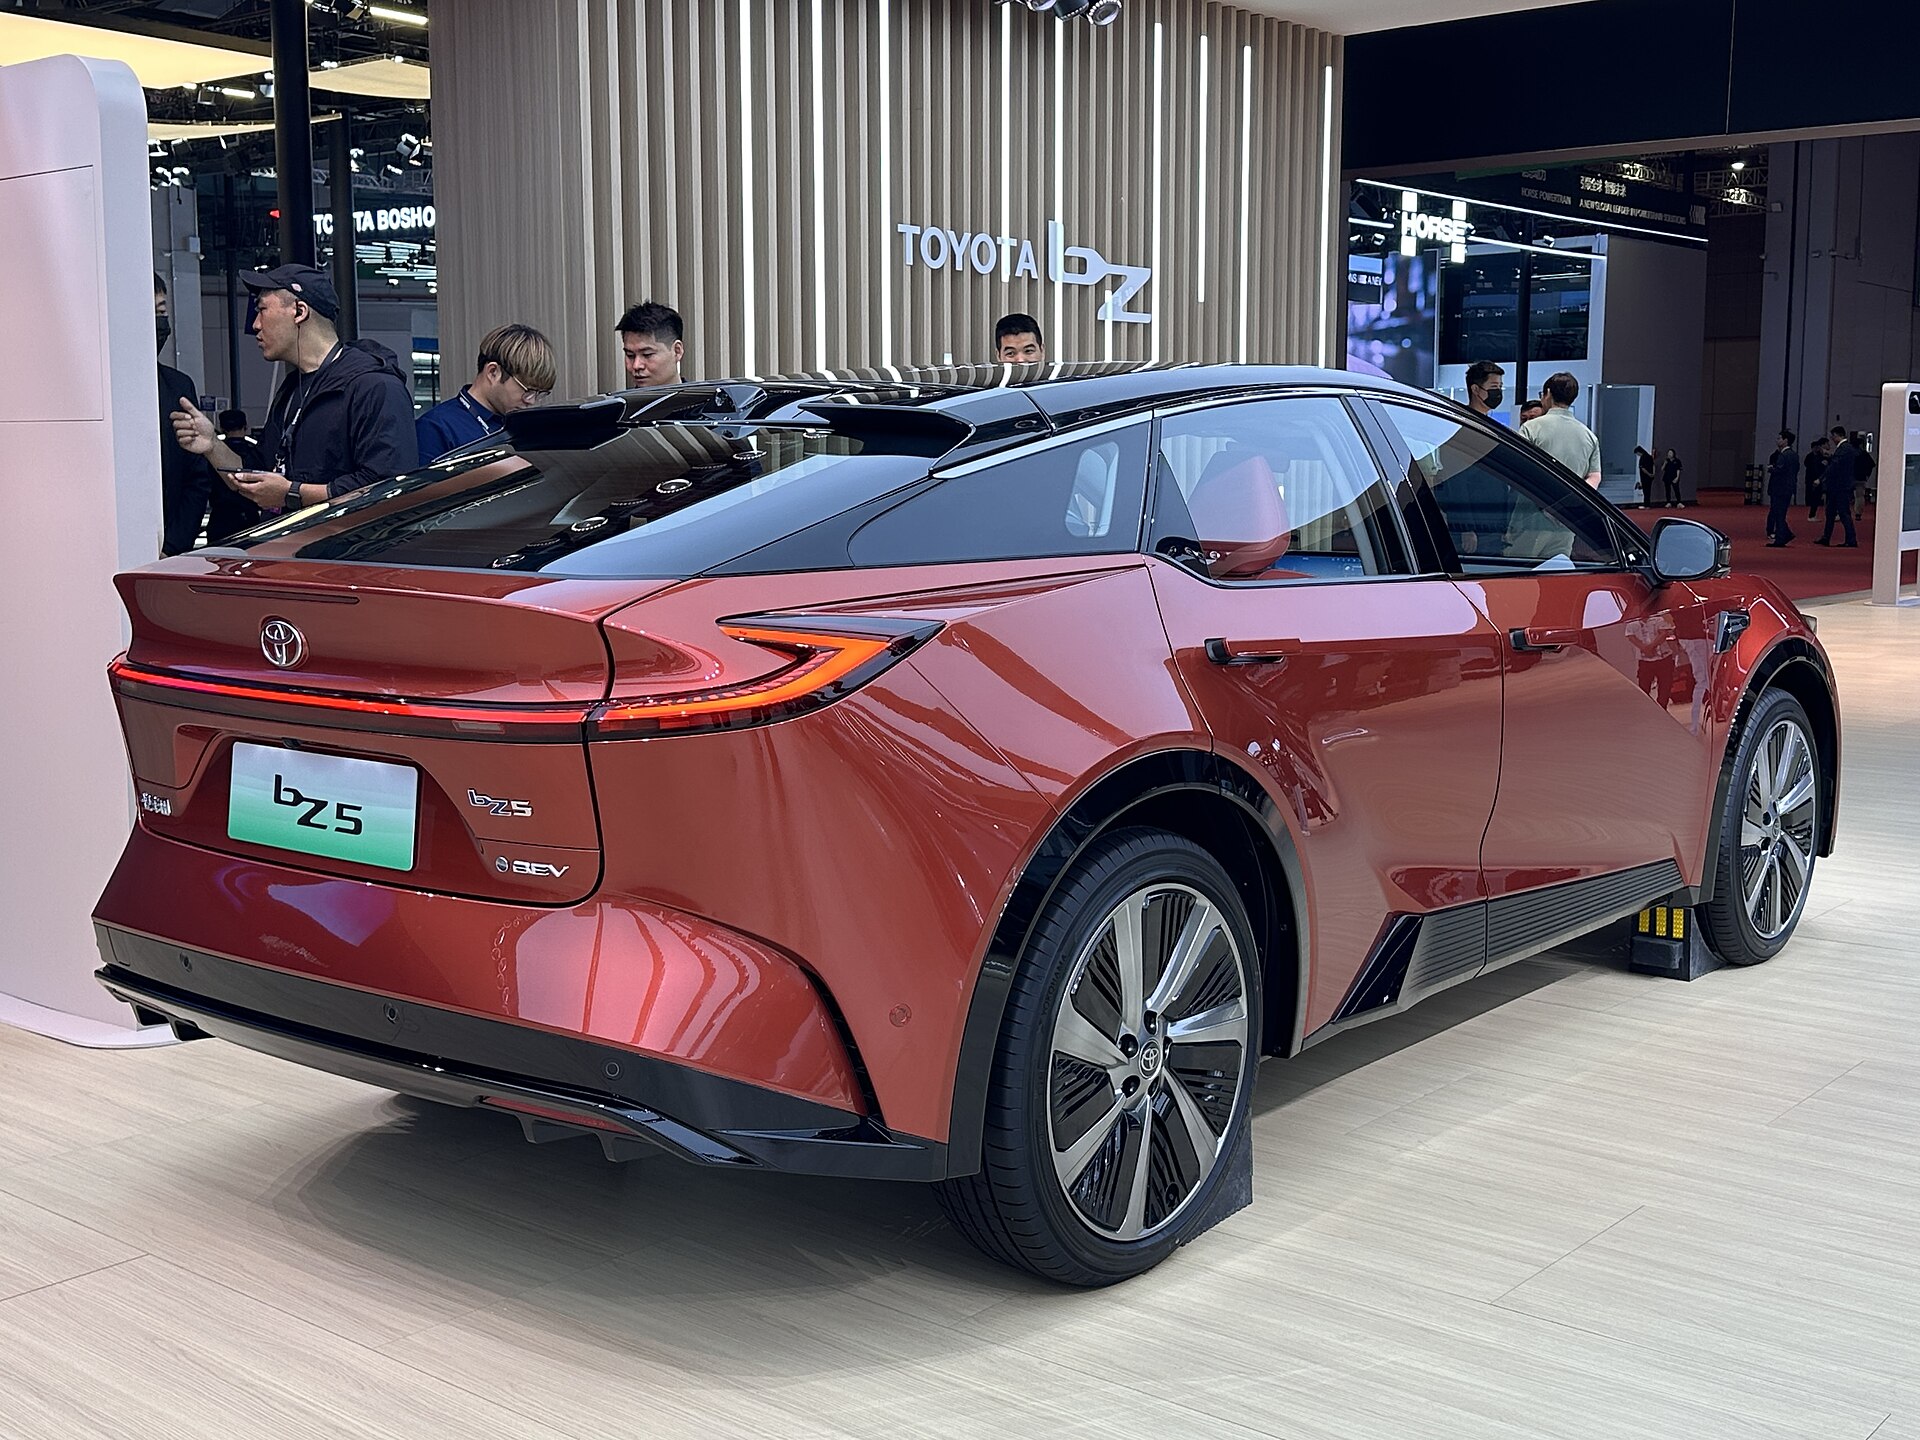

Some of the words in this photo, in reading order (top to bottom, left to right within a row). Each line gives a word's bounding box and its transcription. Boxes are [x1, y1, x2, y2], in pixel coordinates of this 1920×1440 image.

[1521, 186, 1539, 199] HORSE
[313, 210, 375, 235] TOTA
[377, 205, 436, 231] BOSHO
[1401, 211, 1466, 243] HORSE
[897, 223, 1038, 281] TOYOTA
[512, 860, 570, 878] BEV
[1041, 954, 1067, 1016] YOKOHAMA
